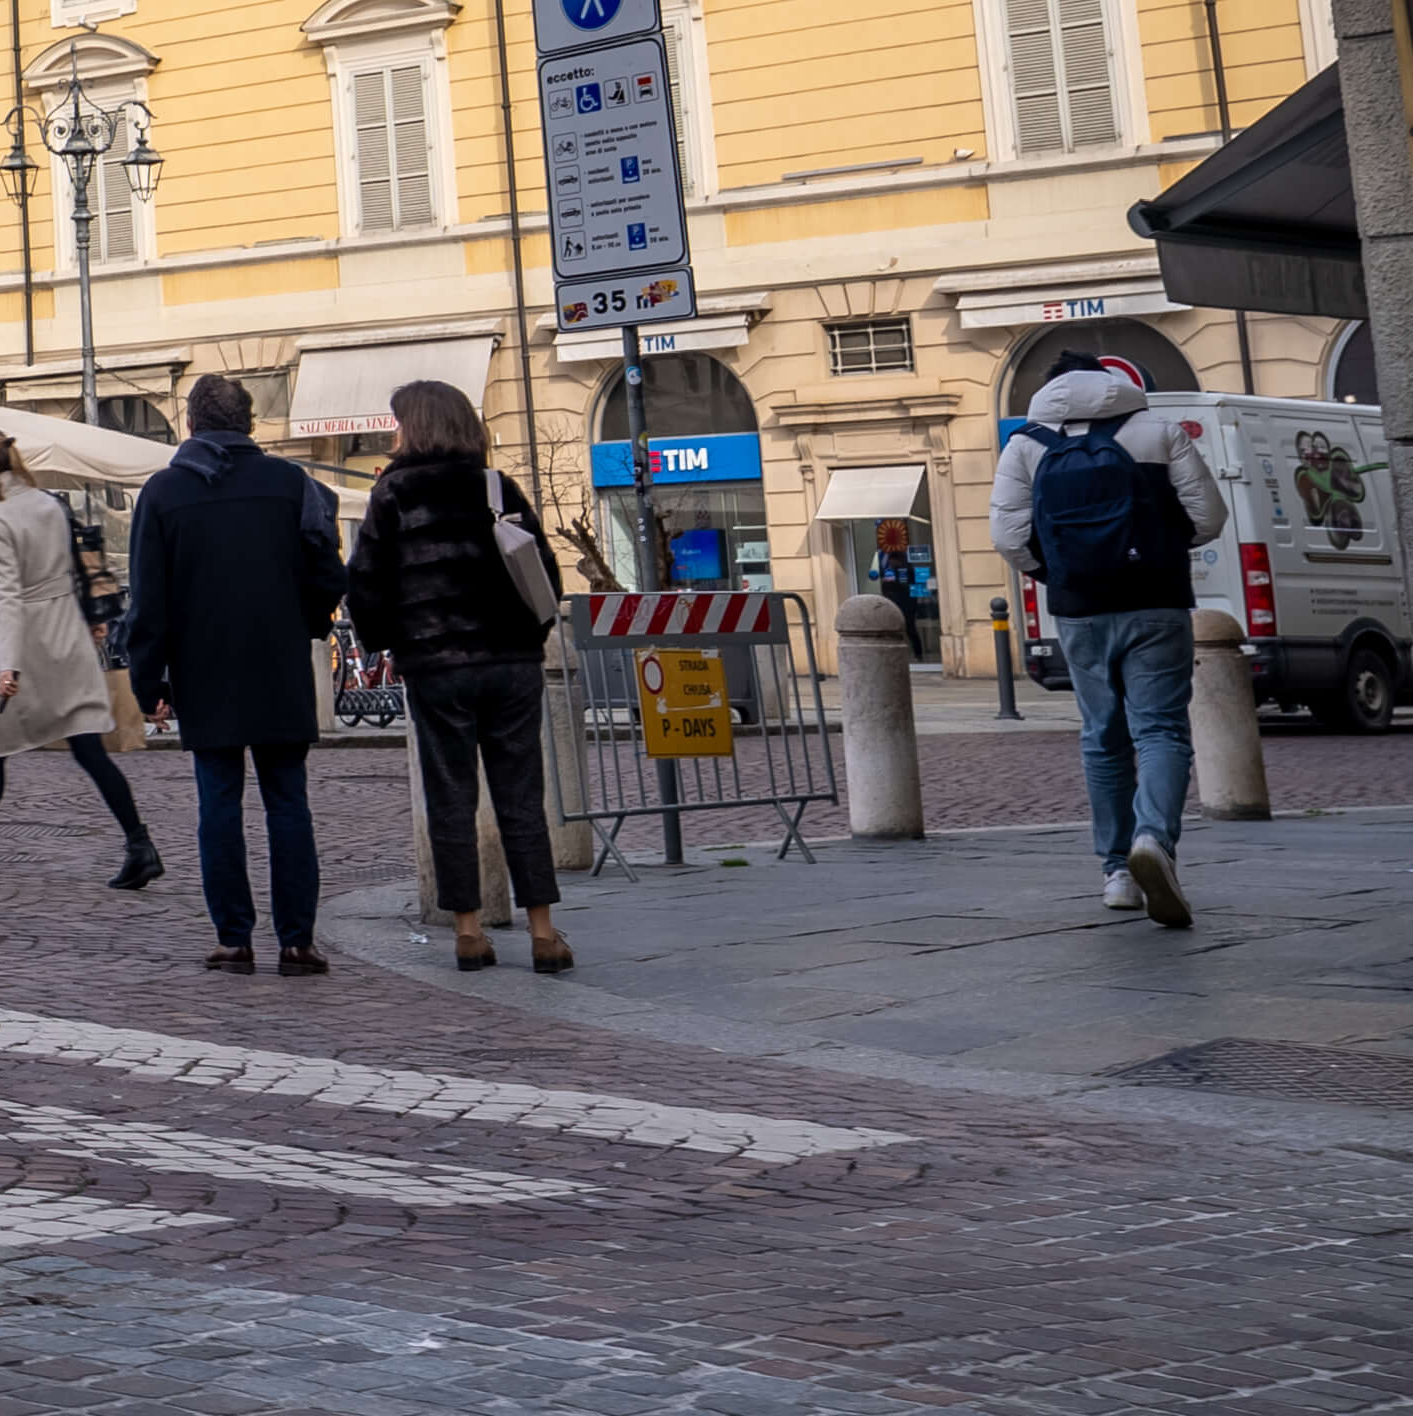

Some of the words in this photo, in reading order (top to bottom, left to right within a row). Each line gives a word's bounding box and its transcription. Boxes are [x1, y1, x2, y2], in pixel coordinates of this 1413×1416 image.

[547, 68, 595, 84] eccetto:
[593, 289, 628, 314] 35
[1066, 297, 1105, 317] TIM
[644, 335, 675, 352] TIM
[300, 419, 355, 433] SALUMERIA
[662, 447, 709, 472] TIM
[678, 659, 709, 671] STRADA
[683, 684, 712, 695] CHIUSA
[662, 718, 671, 738] P
[683, 718, 716, 737] DAYS
